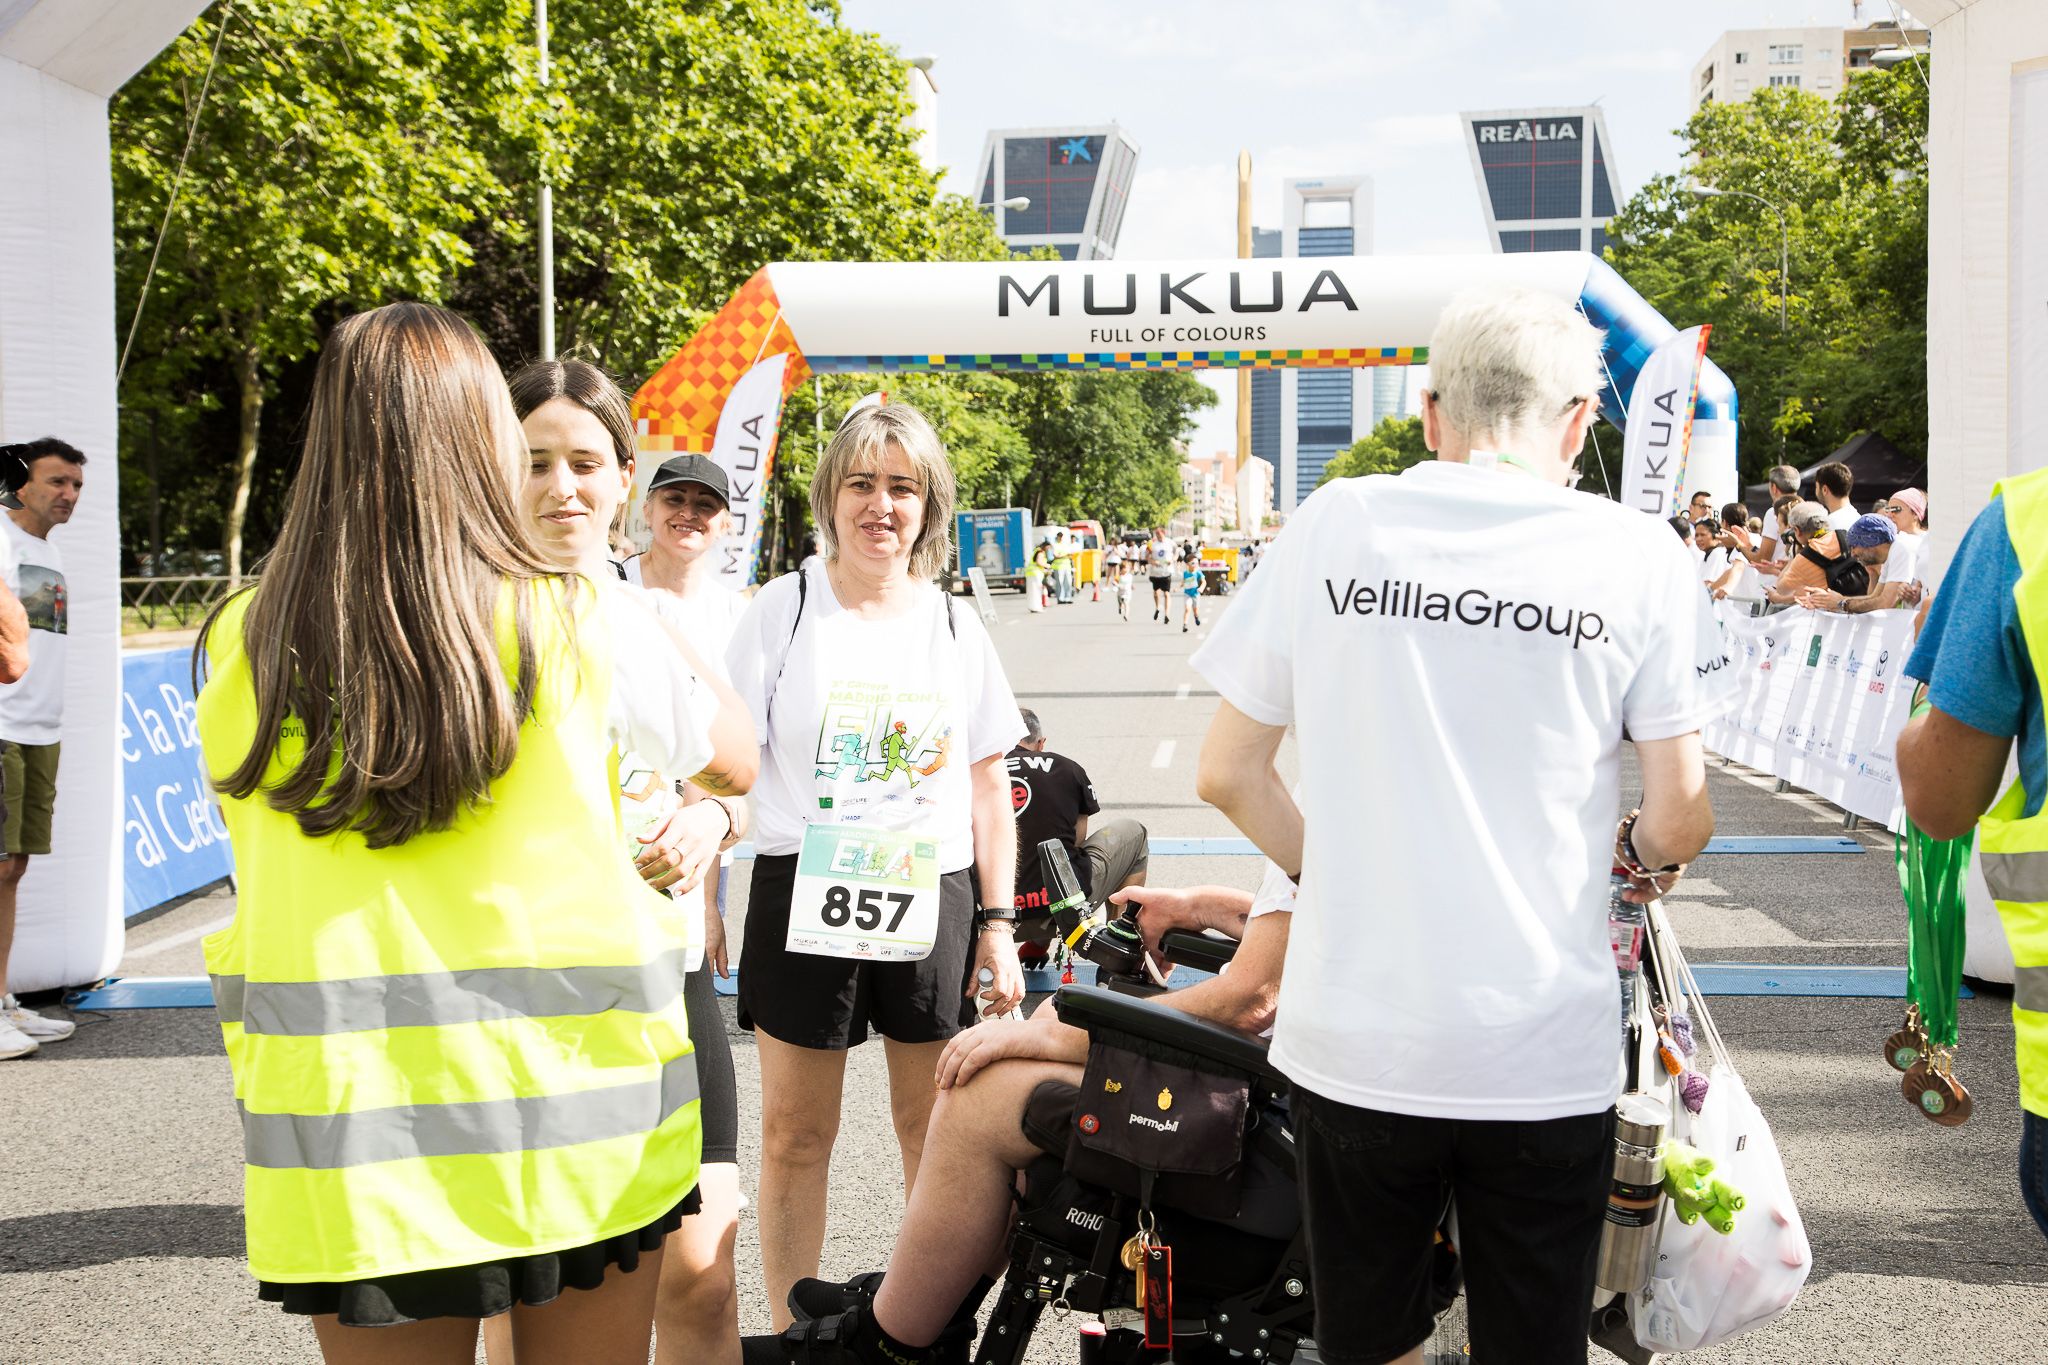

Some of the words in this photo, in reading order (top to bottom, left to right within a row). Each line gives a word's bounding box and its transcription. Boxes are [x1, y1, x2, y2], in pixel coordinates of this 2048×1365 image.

[998, 270, 1359, 317] MUKUA
[1091, 327, 1134, 343] FULL
[1141, 327, 1166, 342] OF
[1173, 326, 1267, 342] COLOURS
[1640, 389, 1677, 514] UKUA
[720, 414, 764, 574] MUKUA
[1325, 578, 1610, 650] VelillaGroup.
[159, 683, 202, 749] Ba
[828, 690, 892, 704] MADRID
[121, 722, 142, 763] e
[124, 691, 176, 756] la
[281, 726, 307, 738] OVIL
[1004, 756, 1055, 773] EW
[125, 794, 168, 868] al
[820, 885, 915, 933] 857
[1014, 887, 1051, 910] ent
[1129, 1113, 1180, 1133] permobil
[1065, 1207, 1105, 1231] ROHO
